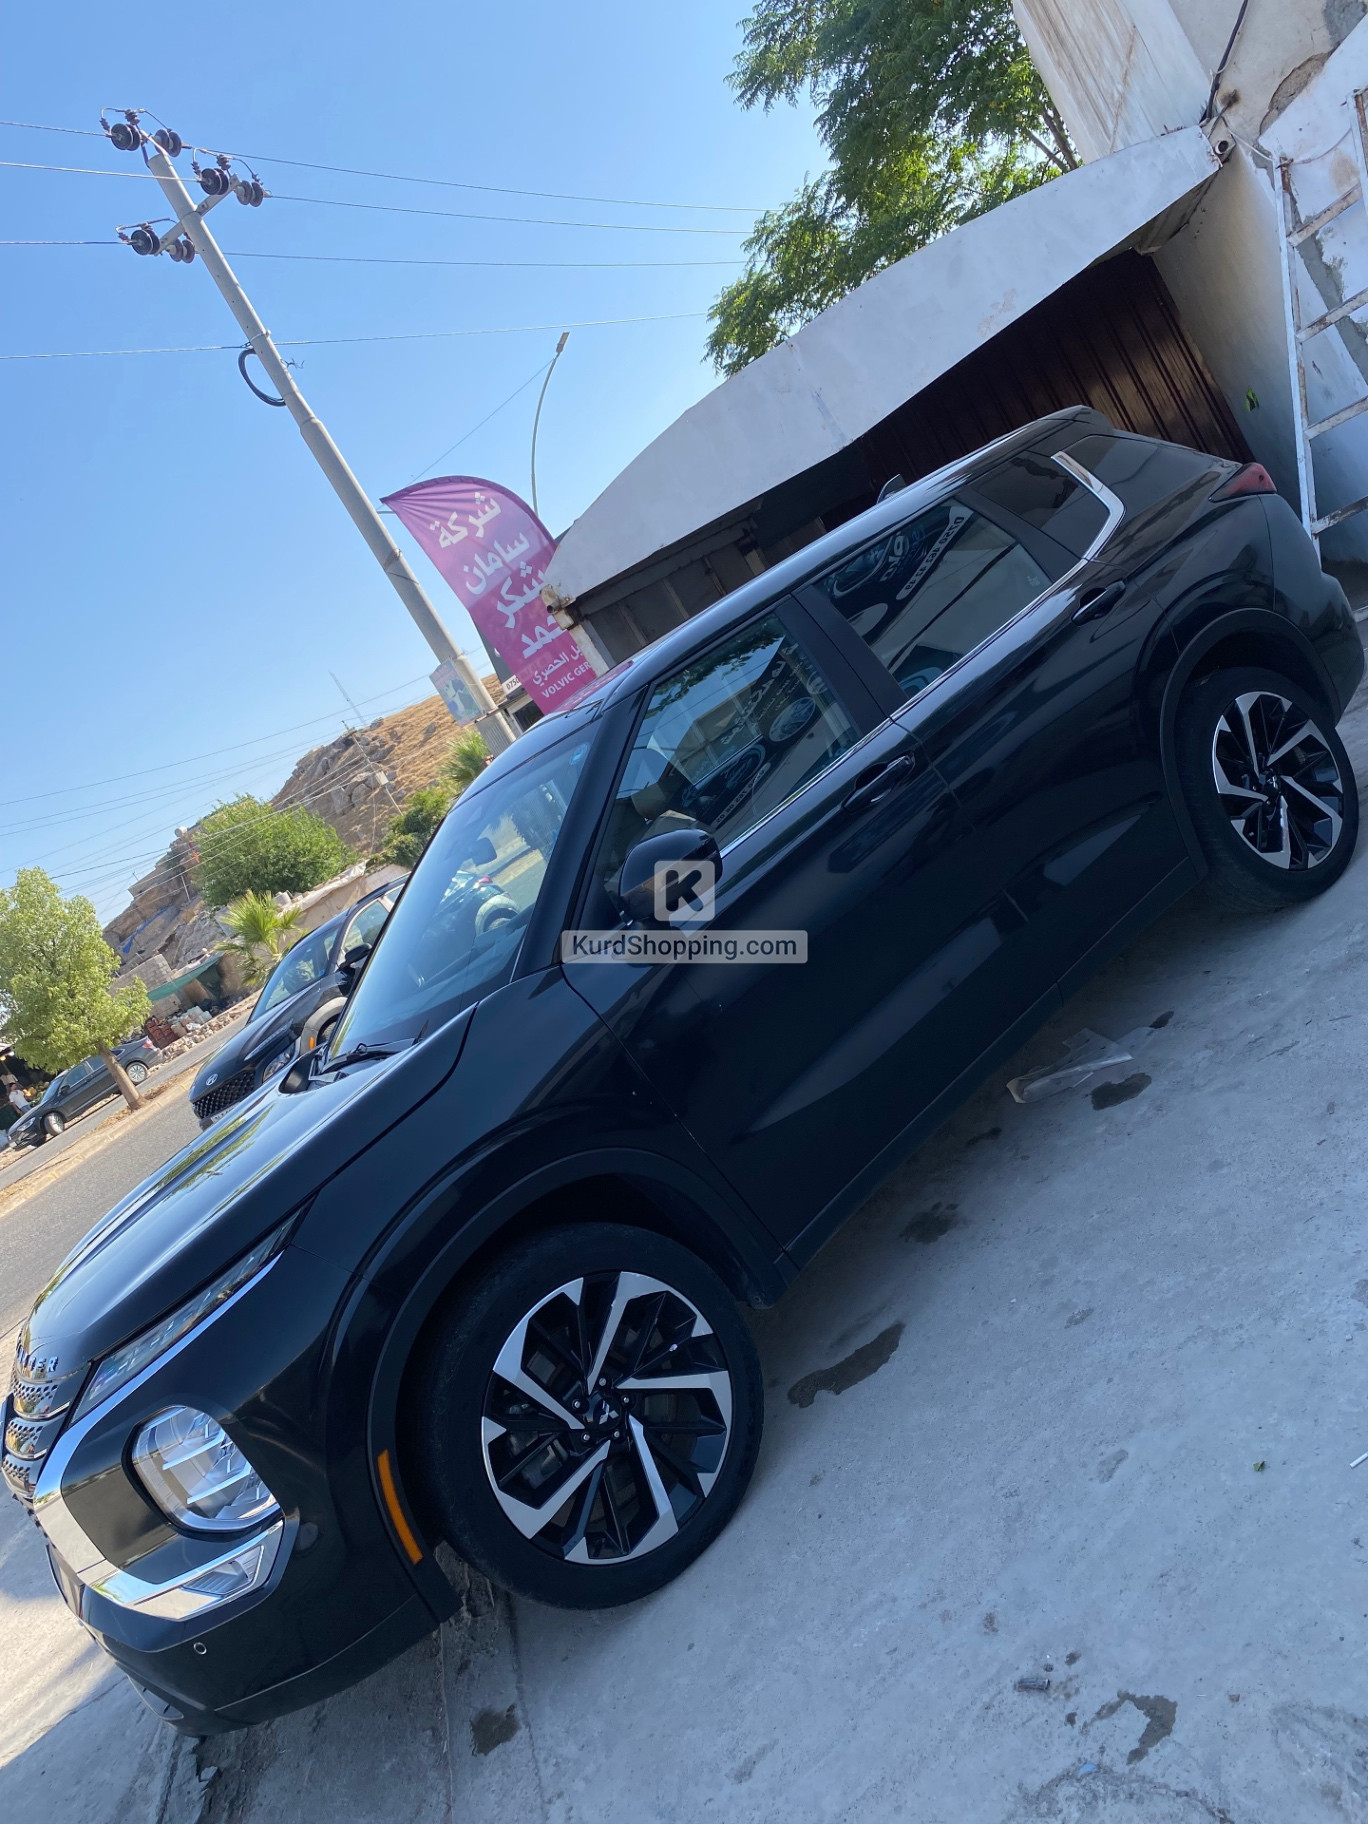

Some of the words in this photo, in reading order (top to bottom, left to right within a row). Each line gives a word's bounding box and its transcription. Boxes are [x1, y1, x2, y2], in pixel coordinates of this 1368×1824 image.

[429, 492, 501, 549] شركة
[463, 533, 530, 595] سامان
[532, 651, 570, 687] الحصري
[541, 672, 577, 699] VOLVIC
[573, 660, 592, 677] GER
